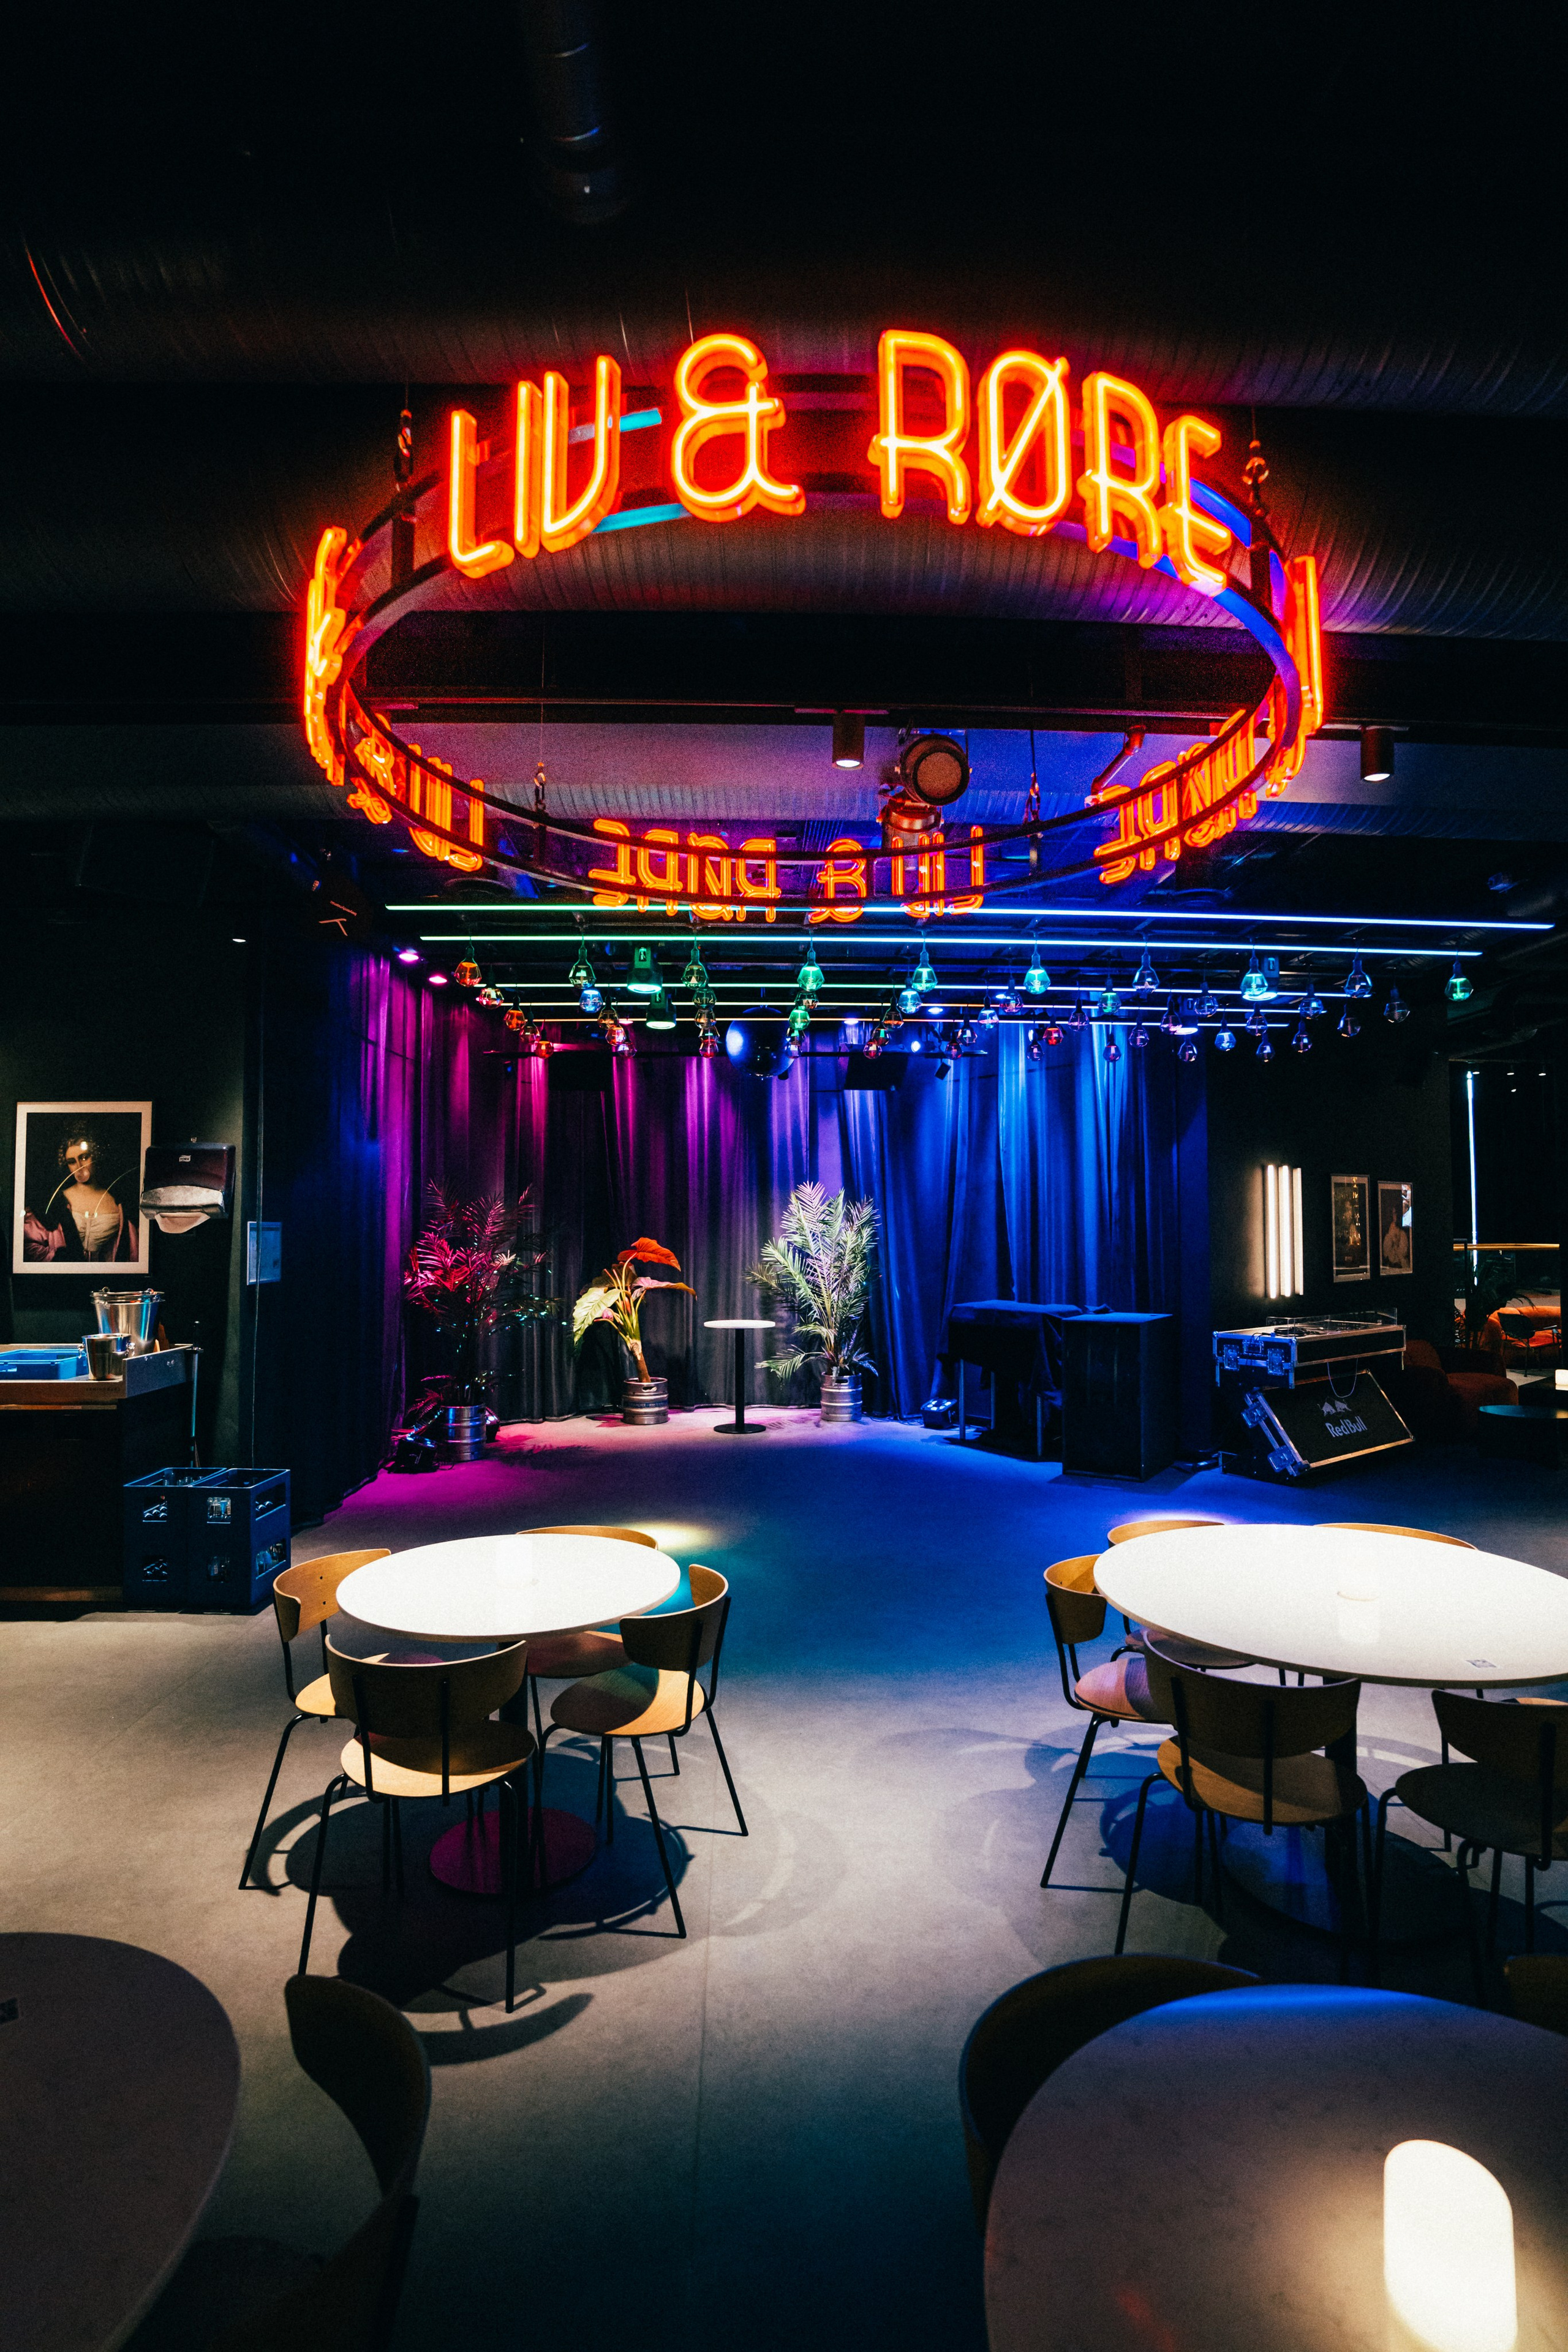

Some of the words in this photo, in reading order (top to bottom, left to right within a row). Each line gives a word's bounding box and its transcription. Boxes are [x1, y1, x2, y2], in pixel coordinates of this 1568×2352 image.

[449, 356, 622, 578] LIV
[671, 334, 805, 522] &
[867, 329, 1231, 595] RØRE
